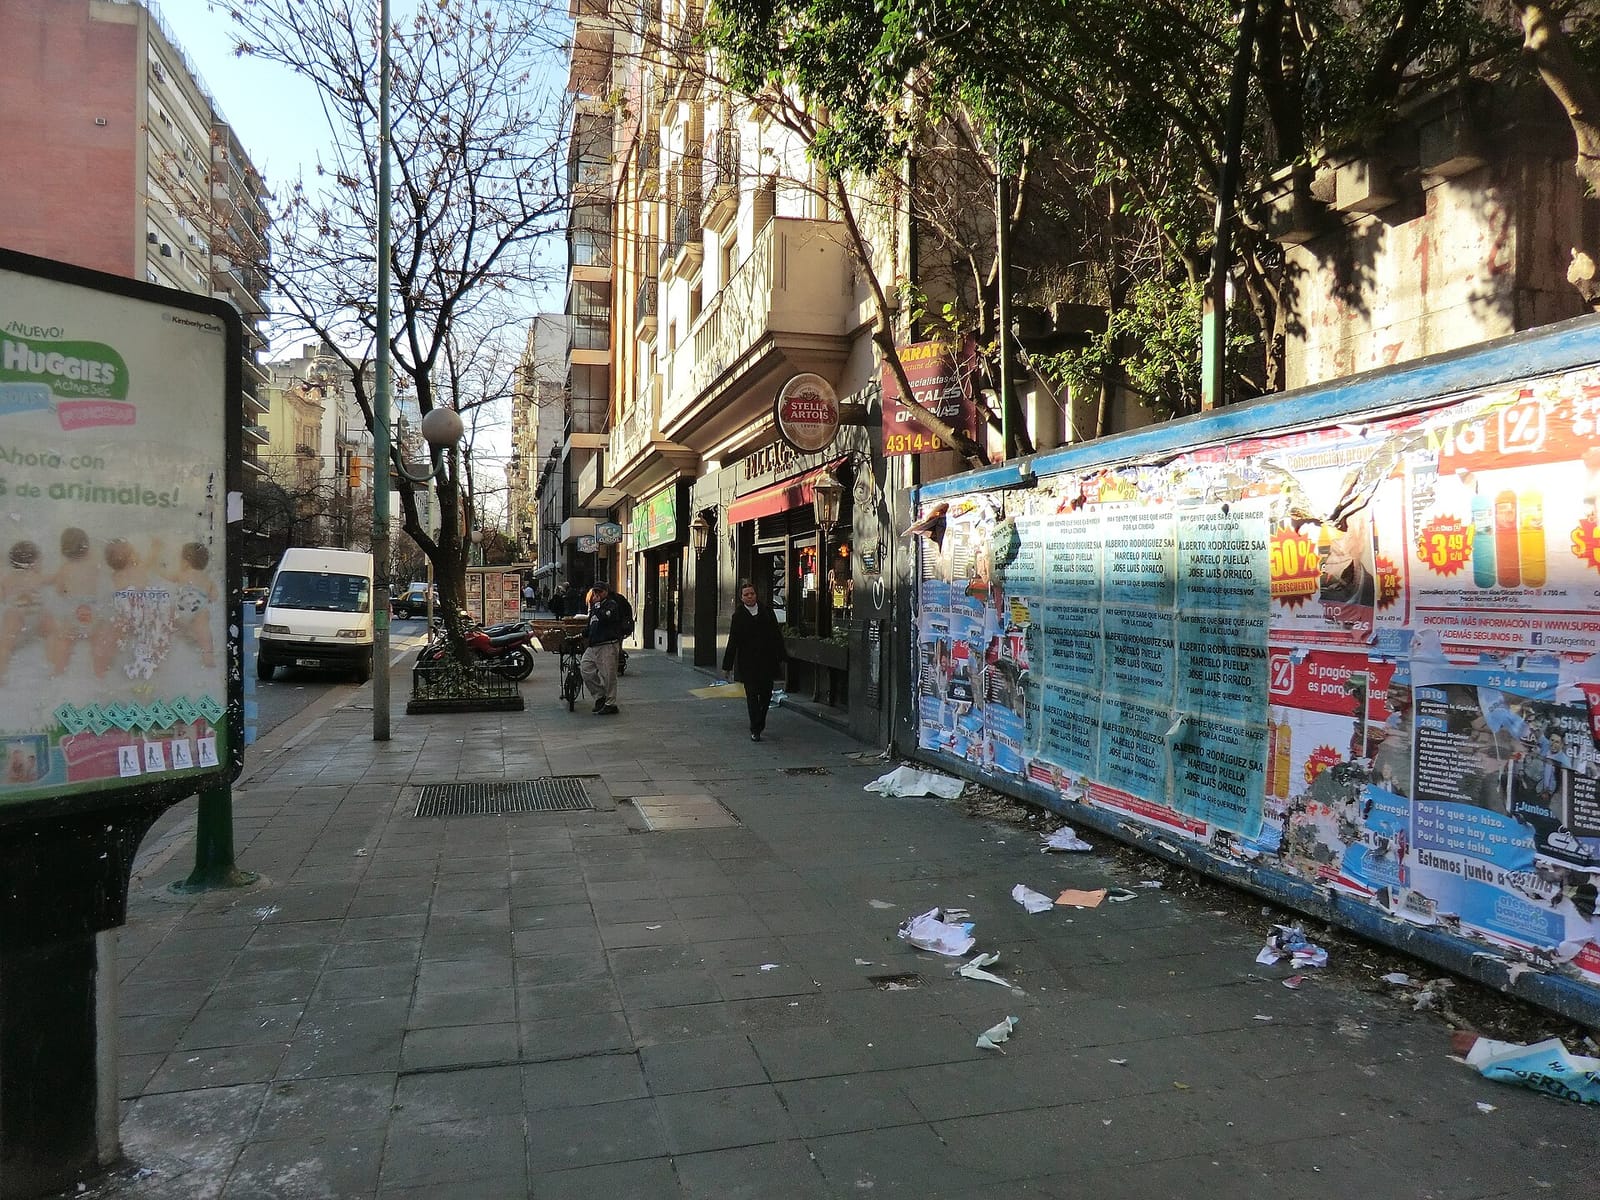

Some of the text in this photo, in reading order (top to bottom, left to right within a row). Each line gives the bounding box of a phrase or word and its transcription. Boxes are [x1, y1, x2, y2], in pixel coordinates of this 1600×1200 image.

[5, 320, 65, 339] ¡NUEVO!
[4, 339, 116, 385] HUGGIES
[54, 379, 90, 395] Active
[791, 402, 829, 411] STELLA
[790, 410, 829, 420] ARTOIS
[69, 453, 105, 471] con
[16, 482, 180, 509] de animales!
[1206, 513, 1217, 522] QUE
[1233, 512, 1244, 521] QUE
[1245, 511, 1264, 520] HACER
[1210, 523, 1217, 531] LA
[1217, 522, 1239, 531] CIUDAD
[1105, 538, 1175, 548] ALBERTO RODRIGUEZ SAA
[1178, 540, 1266, 551] ALBERTO RODRIGUEZ SAA
[1114, 551, 1162, 561] MARCELO PUELLA
[1190, 555, 1250, 565] MARCELO PUELLA
[1270, 538, 1318, 577] 50%
[1112, 563, 1164, 573] JOSE LUIS ORRICO
[1188, 568, 1253, 579] JOSE LUIS ORRICO
[1424, 615, 1459, 626] ENCONTRÁ
[1461, 615, 1477, 626] MÁS
[1479, 617, 1531, 629] INFORMACIÓN
[1532, 620, 1543, 629] EN
[1442, 628, 1472, 639] ADEMÁS
[1473, 631, 1511, 642] SEGUINOS
[1179, 642, 1267, 659] ALBERTO RODRIGUEZ SAA
[1190, 656, 1249, 671] MARCELO PUELLA
[1308, 662, 1351, 679] Si pagás
[1188, 669, 1252, 686] JOSE LUIS ORRICO
[1488, 675, 1548, 692] 25 de mayo
[1307, 681, 1319, 692] es
[1208, 721, 1218, 731] QUE
[1219, 723, 1233, 733] SABE
[1233, 727, 1245, 737] QUE
[1245, 730, 1265, 741] HACER
[1421, 718, 1442, 729] 2003
[1199, 730, 1210, 739] POR
[1218, 735, 1239, 745] CIUDAD
[1173, 742, 1264, 773] ALBERTO RODRIGUEZ SAA
[1187, 757, 1245, 783] MARCELO PUELLA
[1185, 770, 1247, 798] JOSE LUIS ORRICO
[1375, 802, 1410, 817] corregir.
[1418, 802, 1505, 828] Por lo que se hizo.
[1418, 816, 1434, 828] Por
[1435, 818, 1445, 830] lo
[1447, 823, 1465, 836] que
[1466, 826, 1486, 840] hay
[1488, 832, 1508, 845] que
[1418, 830, 1495, 855] Por lo que falta.
[1418, 848, 1461, 874] Estamos
[1464, 859, 1494, 883] junto
